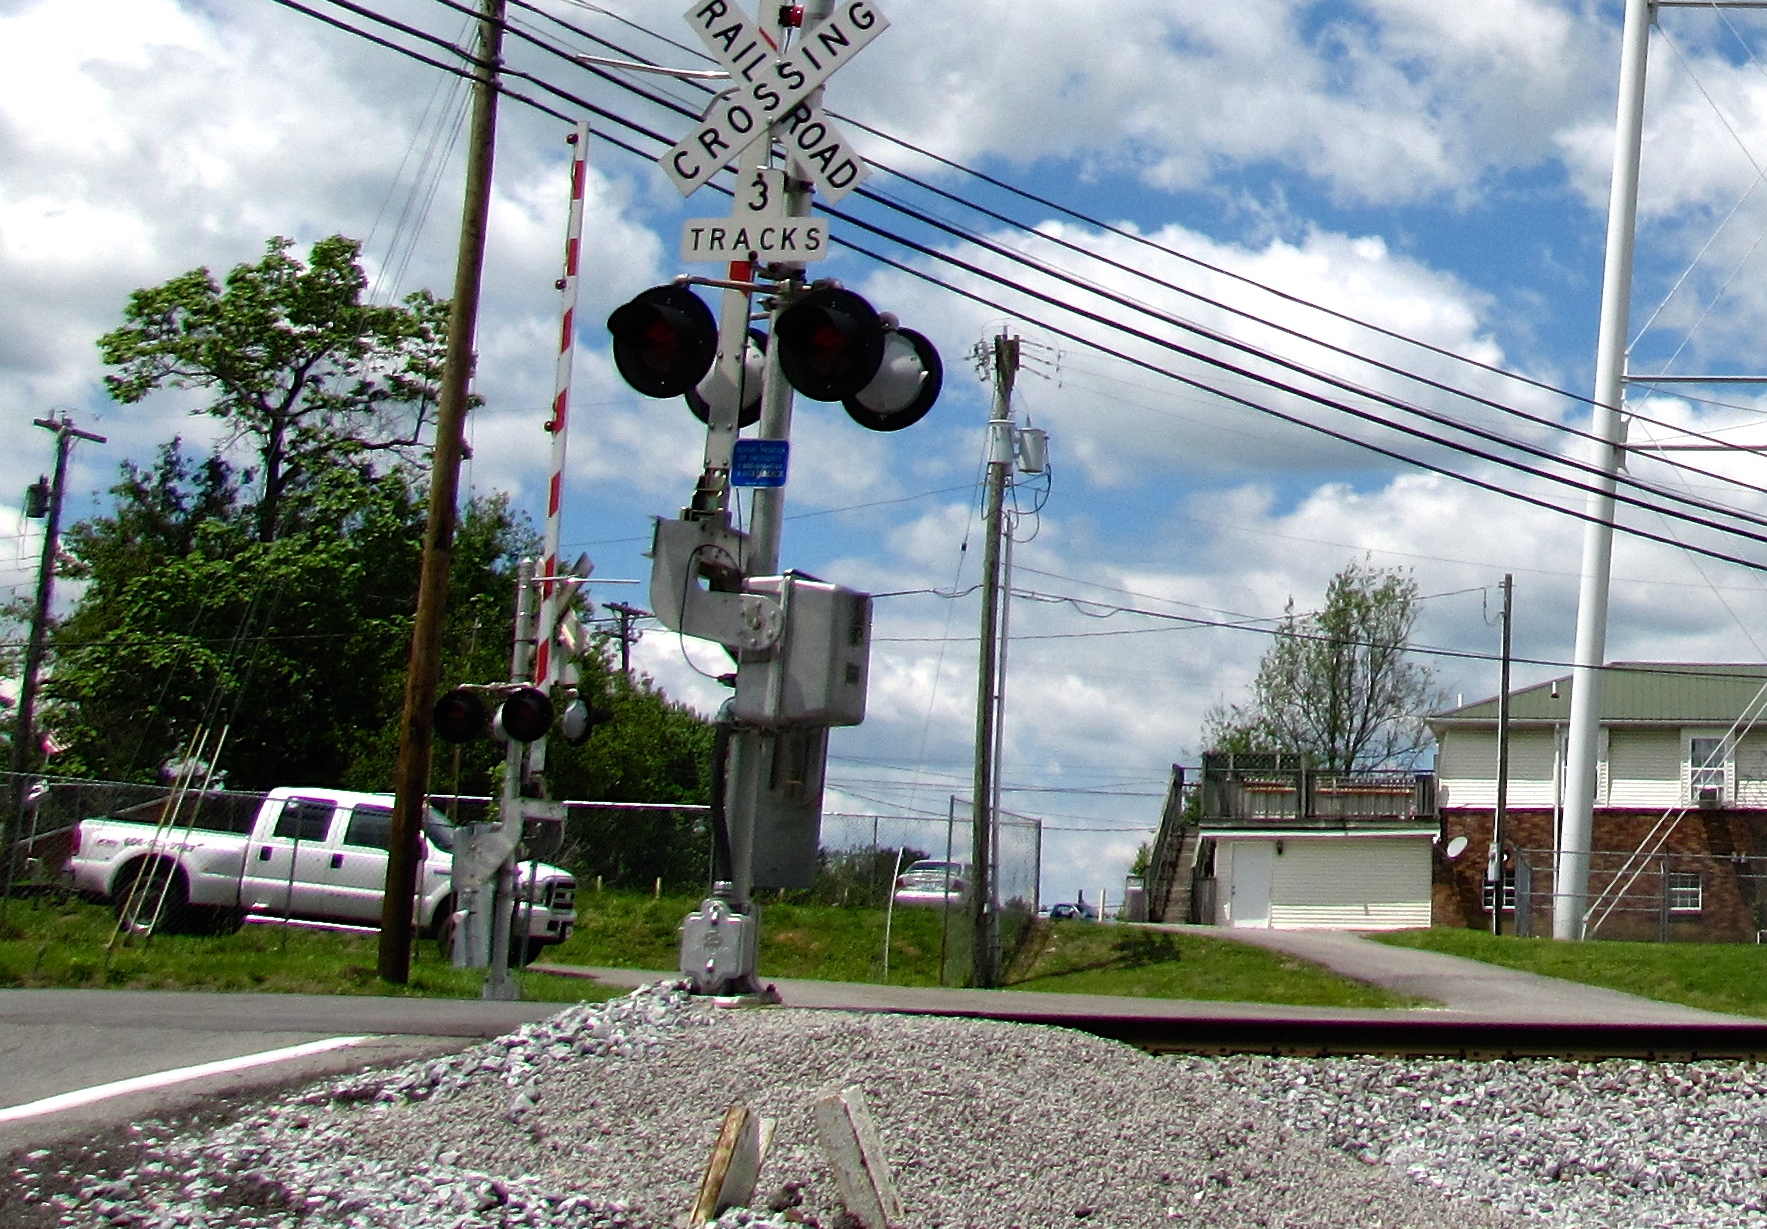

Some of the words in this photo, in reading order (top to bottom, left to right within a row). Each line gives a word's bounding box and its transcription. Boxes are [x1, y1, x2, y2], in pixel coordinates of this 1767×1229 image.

[673, 2, 876, 180] CROSSING
[748, 178, 769, 211] 3
[690, 228, 820, 251] TRACKS
